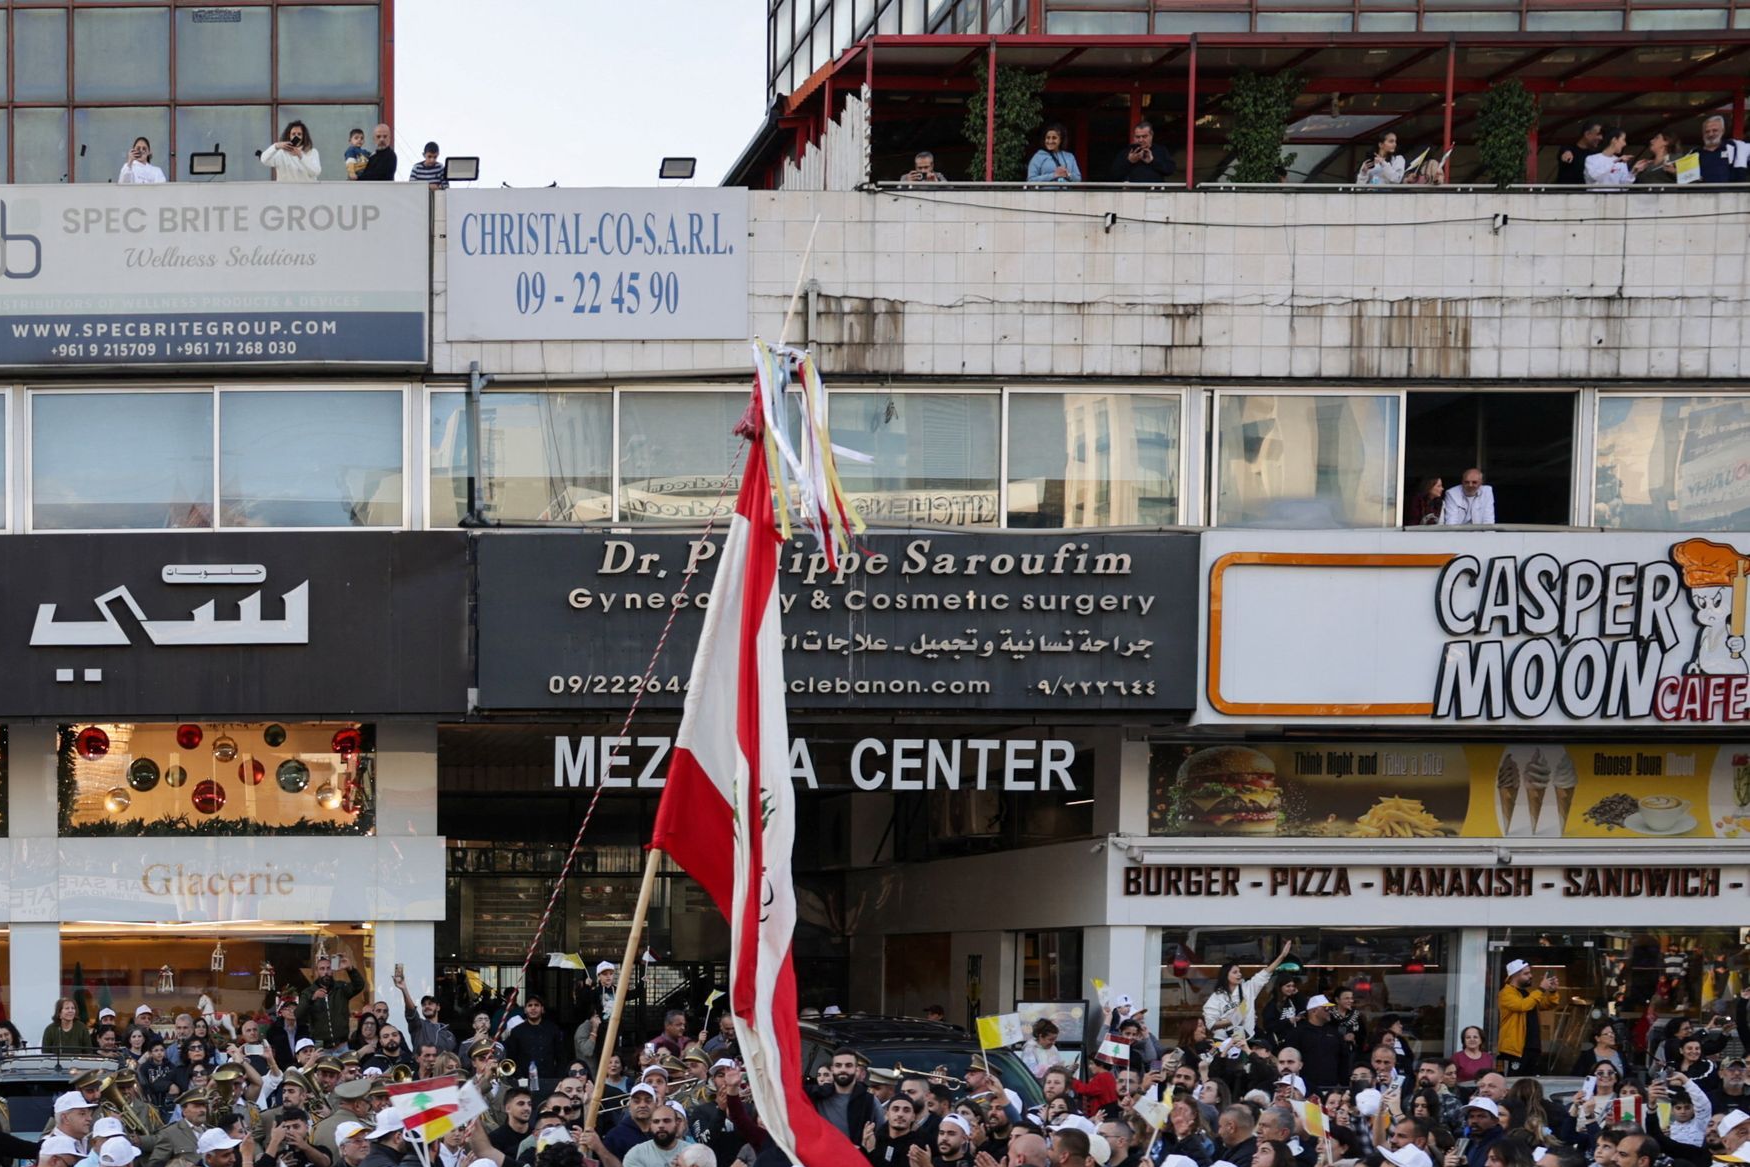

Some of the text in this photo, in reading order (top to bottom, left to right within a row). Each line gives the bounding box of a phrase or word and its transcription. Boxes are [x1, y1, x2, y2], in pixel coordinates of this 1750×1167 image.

[62, 204, 381, 234] SPEC BRITE GROUP
[123, 244, 319, 269] Wellness Solutions
[121, 295, 199, 309] WELLNESS
[202, 295, 282, 308] PRODUCTS
[298, 294, 362, 307] DEVICES
[515, 271, 546, 315] 09
[572, 271, 602, 315] 22
[610, 271, 641, 315] 45
[649, 271, 680, 315] 90
[11, 320, 338, 338] WWW.SPECBRITEGROUP.COM
[51, 343, 85, 357] +961
[89, 343, 99, 356] 9
[103, 342, 157, 356] 215709
[176, 342, 211, 356] +961
[216, 341, 234, 355] 71
[237, 341, 264, 354] 268
[268, 341, 297, 354] 030
[598, 539, 1134, 585] Dr. Pippe Saroufim
[568, 587, 1155, 615] Gynecoy & Cosmetic surgery
[1436, 552, 1681, 655] CASPER
[1431, 637, 1665, 721] MOON
[1652, 675, 1750, 723] CAFE
[554, 735, 1077, 792] MEZA CENTER
[1294, 750, 1323, 776] Think
[1326, 751, 1355, 777] Right
[1357, 751, 1378, 775] and
[1593, 752, 1633, 777] Choose
[141, 862, 295, 898] Glacerie
[1123, 866, 1241, 897] BURGER
[1269, 866, 1352, 897] PIZZA
[1382, 866, 1534, 897] MANAKISH
[1562, 867, 1722, 897] SANDWICH
